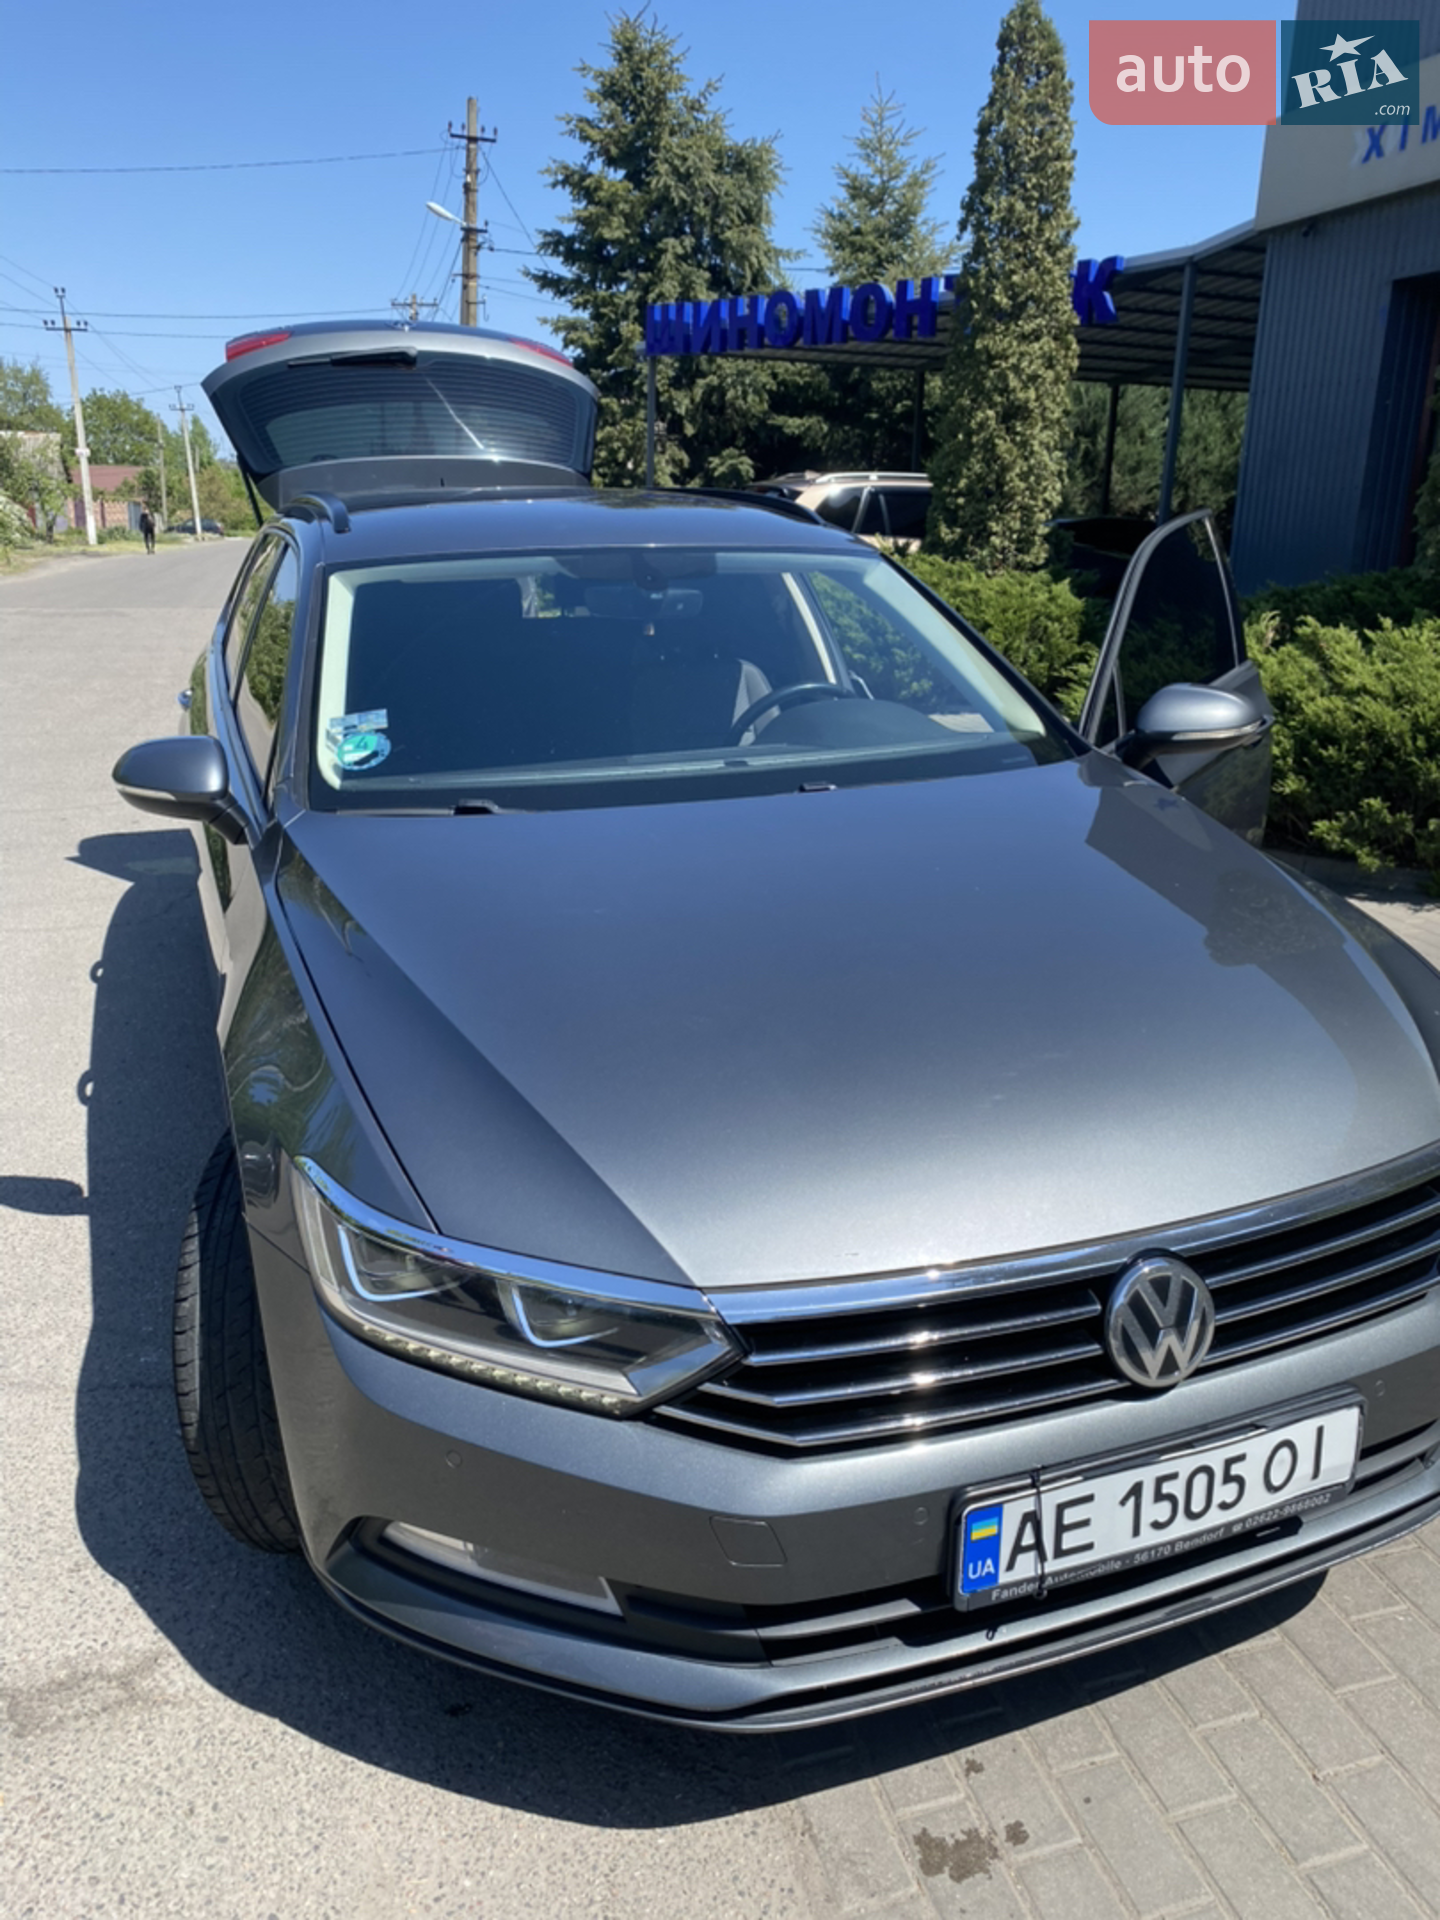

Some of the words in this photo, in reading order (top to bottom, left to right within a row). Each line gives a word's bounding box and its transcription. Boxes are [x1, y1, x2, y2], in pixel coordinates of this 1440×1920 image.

[1004, 1493, 1096, 1573] AE
[1119, 1453, 1247, 1539] 1505
[967, 1557, 996, 1580] UA
